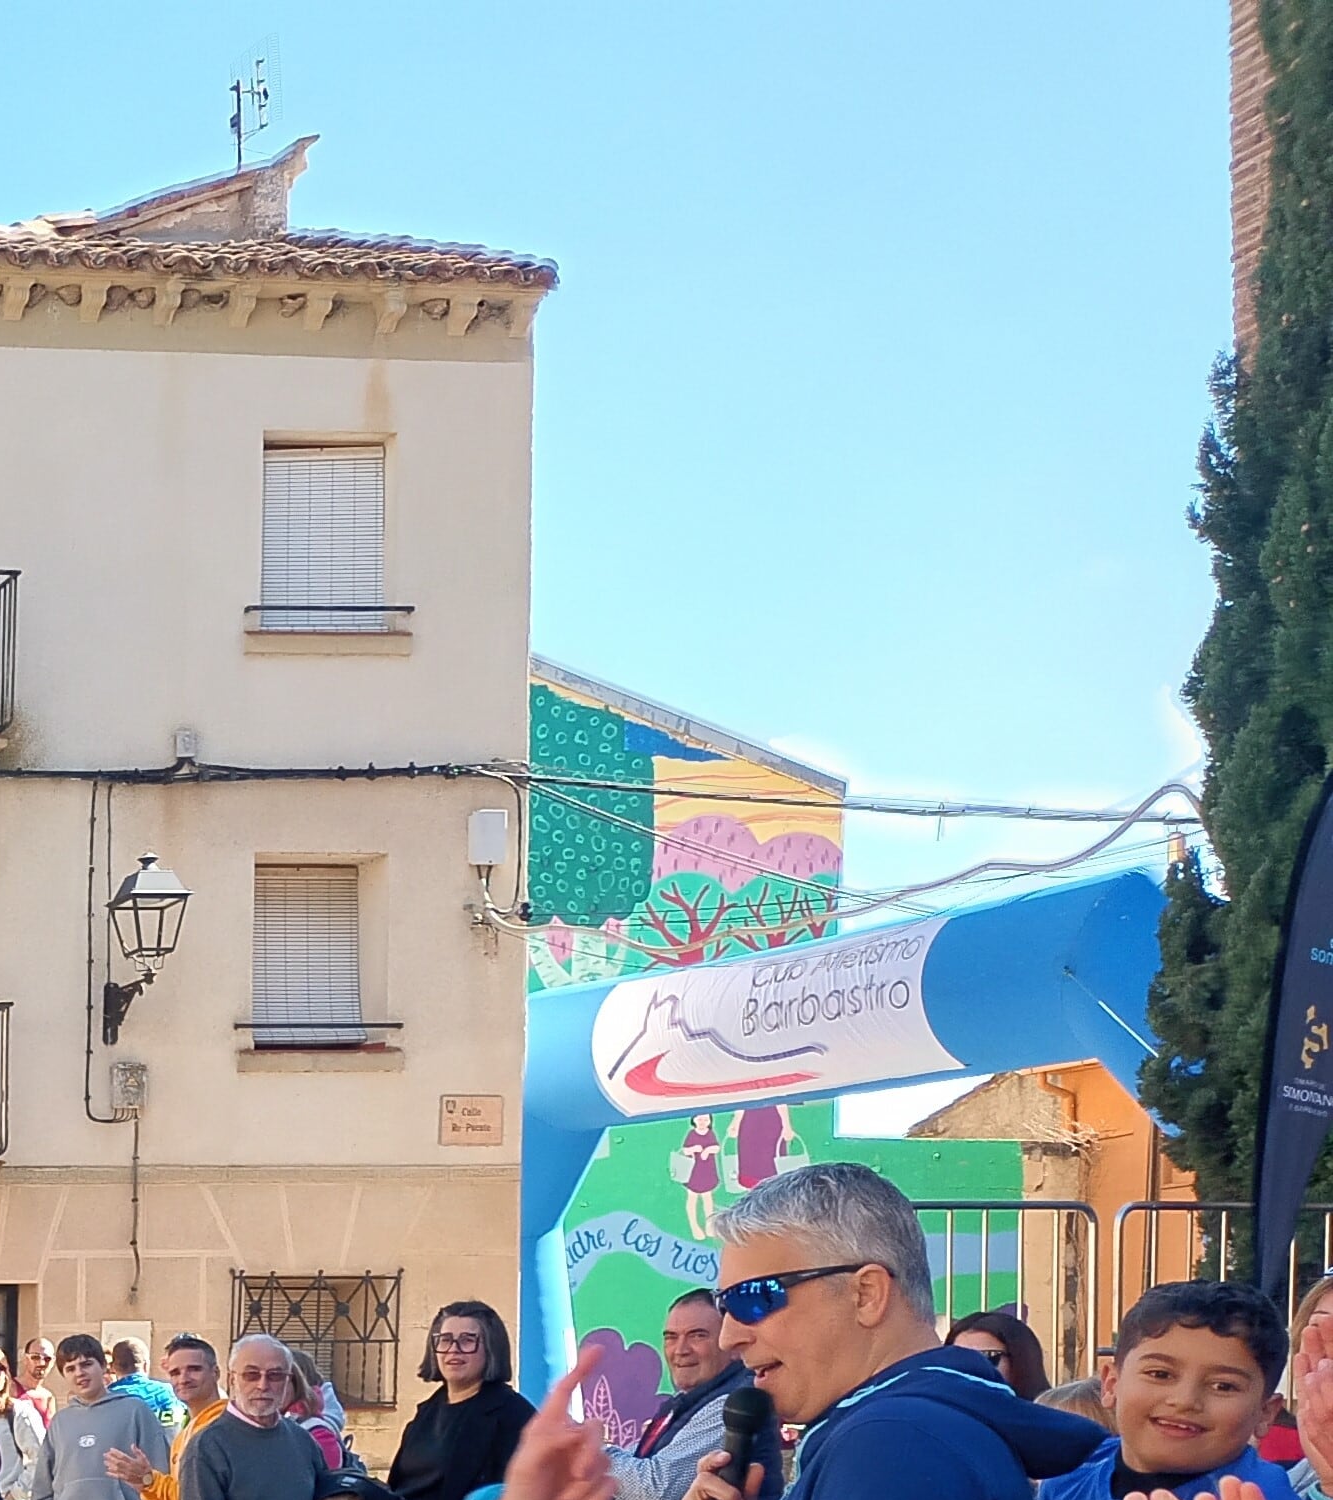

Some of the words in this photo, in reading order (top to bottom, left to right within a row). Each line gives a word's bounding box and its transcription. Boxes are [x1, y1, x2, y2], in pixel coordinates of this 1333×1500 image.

[752, 960, 806, 988] Club
[741, 974, 910, 1037] Barbastro
[621, 1218, 663, 1257] los
